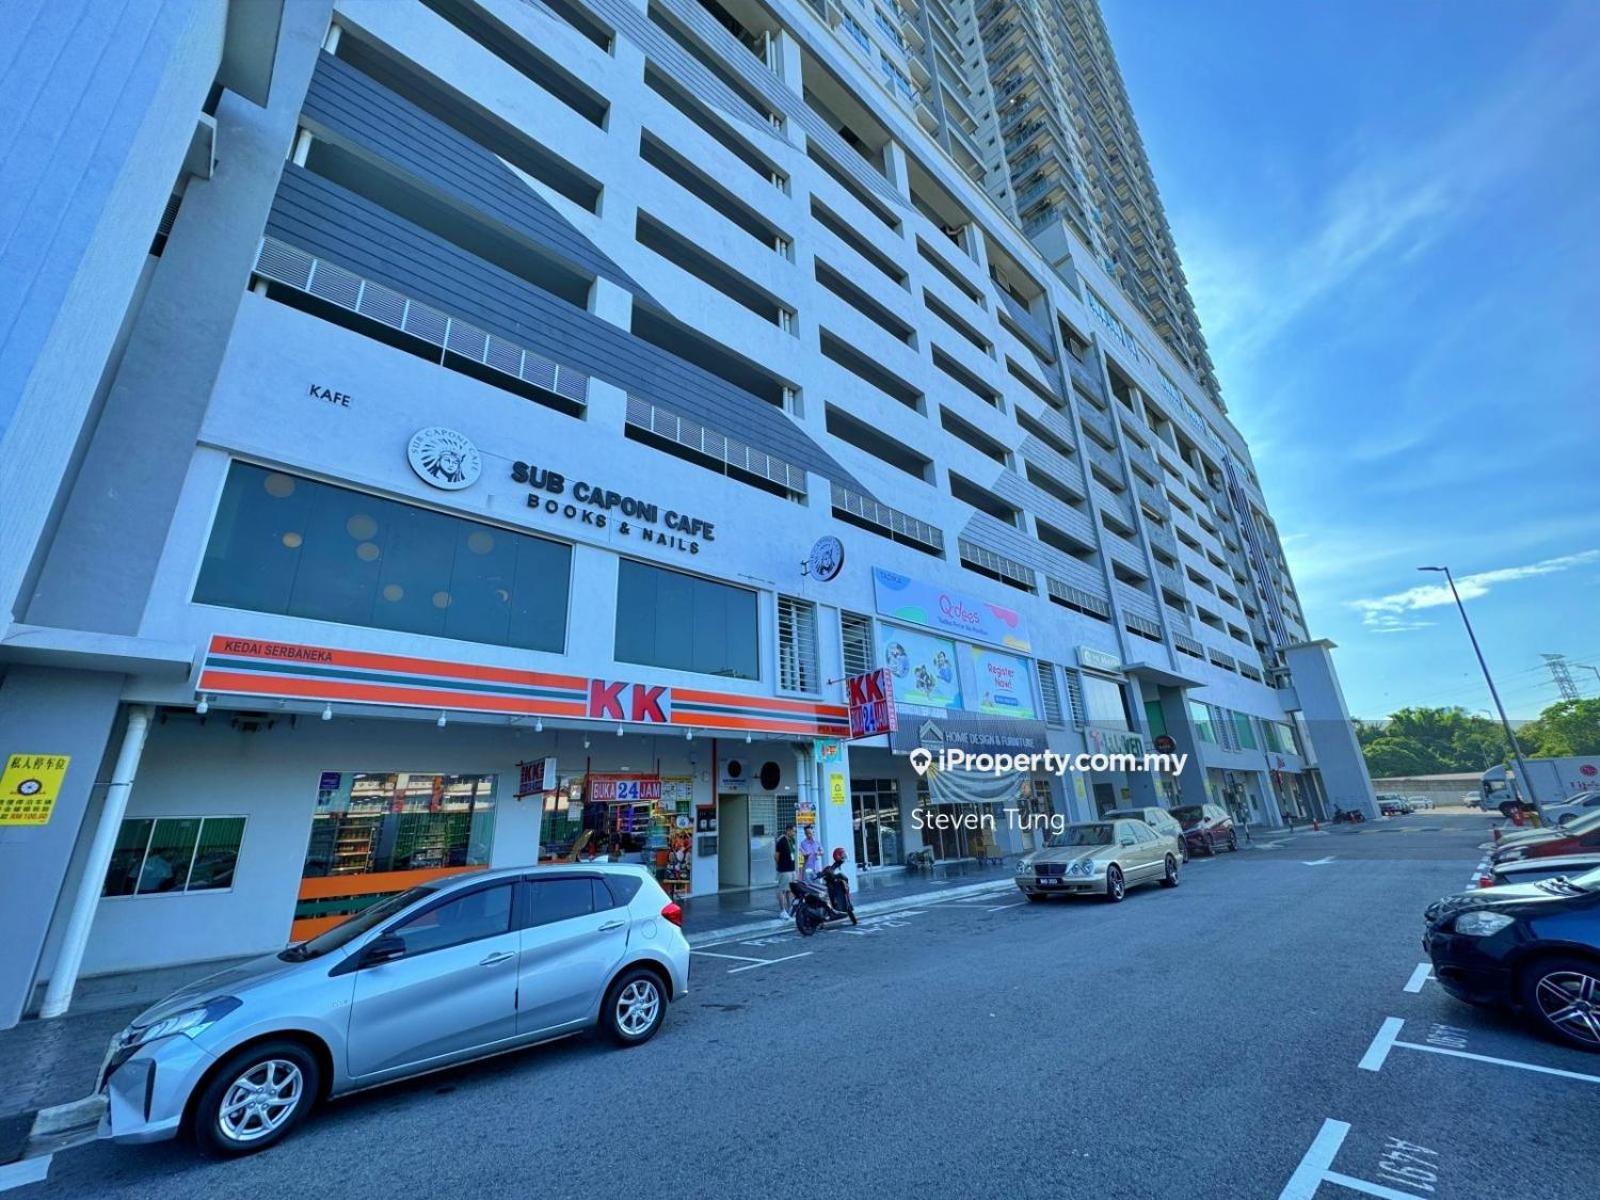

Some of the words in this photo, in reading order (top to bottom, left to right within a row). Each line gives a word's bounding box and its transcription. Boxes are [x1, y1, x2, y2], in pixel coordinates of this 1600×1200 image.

[310, 383, 351, 408] KAFE
[511, 460, 565, 494] SUB
[572, 481, 658, 524] CAPONI
[664, 510, 715, 541] CAFE
[527, 493, 607, 528] BOOKS
[619, 521, 630, 535] &
[642, 527, 700, 555] NAILS
[224, 640, 263, 655] KEDAI
[264, 644, 333, 662] SERBANEKA
[988, 663, 1014, 678] Register
[590, 679, 668, 723] KK
[850, 669, 885, 706] KK
[863, 702, 876, 732] 24
[945, 730, 968, 744] HOME
[970, 732, 995, 745] DESIGN
[1001, 736, 1035, 748] FURNITURE
[594, 783, 615, 799] BUKA
[618, 781, 639, 799] 24
[640, 783, 660, 798] JAM
